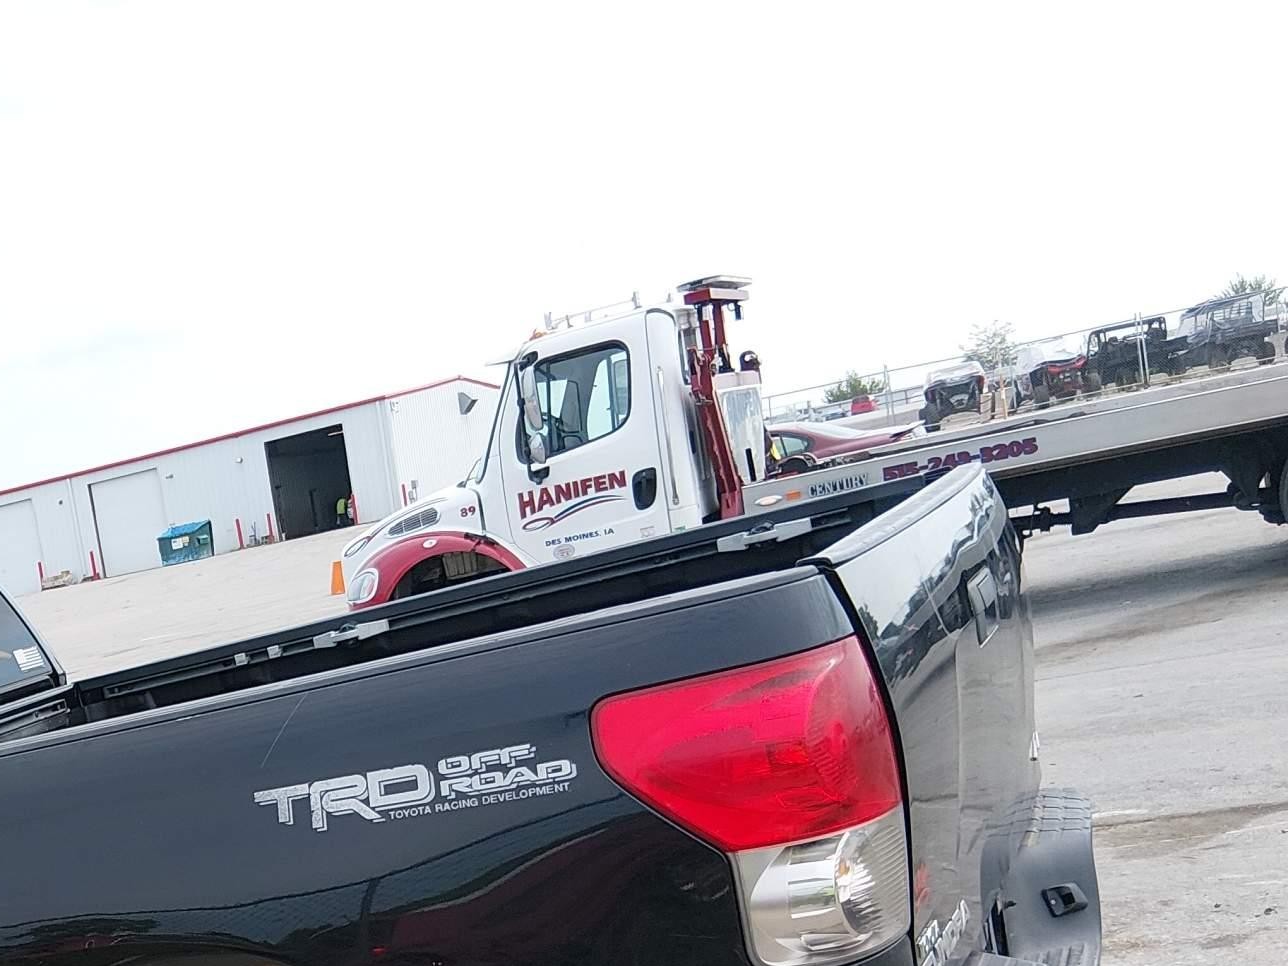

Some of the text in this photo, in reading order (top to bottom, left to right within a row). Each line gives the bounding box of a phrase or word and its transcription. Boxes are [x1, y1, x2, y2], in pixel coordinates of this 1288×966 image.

[517, 470, 628, 520] HANIFEN
[808, 473, 870, 498] CENTURY
[460, 506, 476, 518] 89
[545, 538, 562, 547] DES
[437, 743, 537, 777] OFF
[253, 764, 436, 832] TRD
[439, 759, 578, 800] ROAD
[388, 781, 571, 821] TOYOTA RACING DEVELOPMENT
